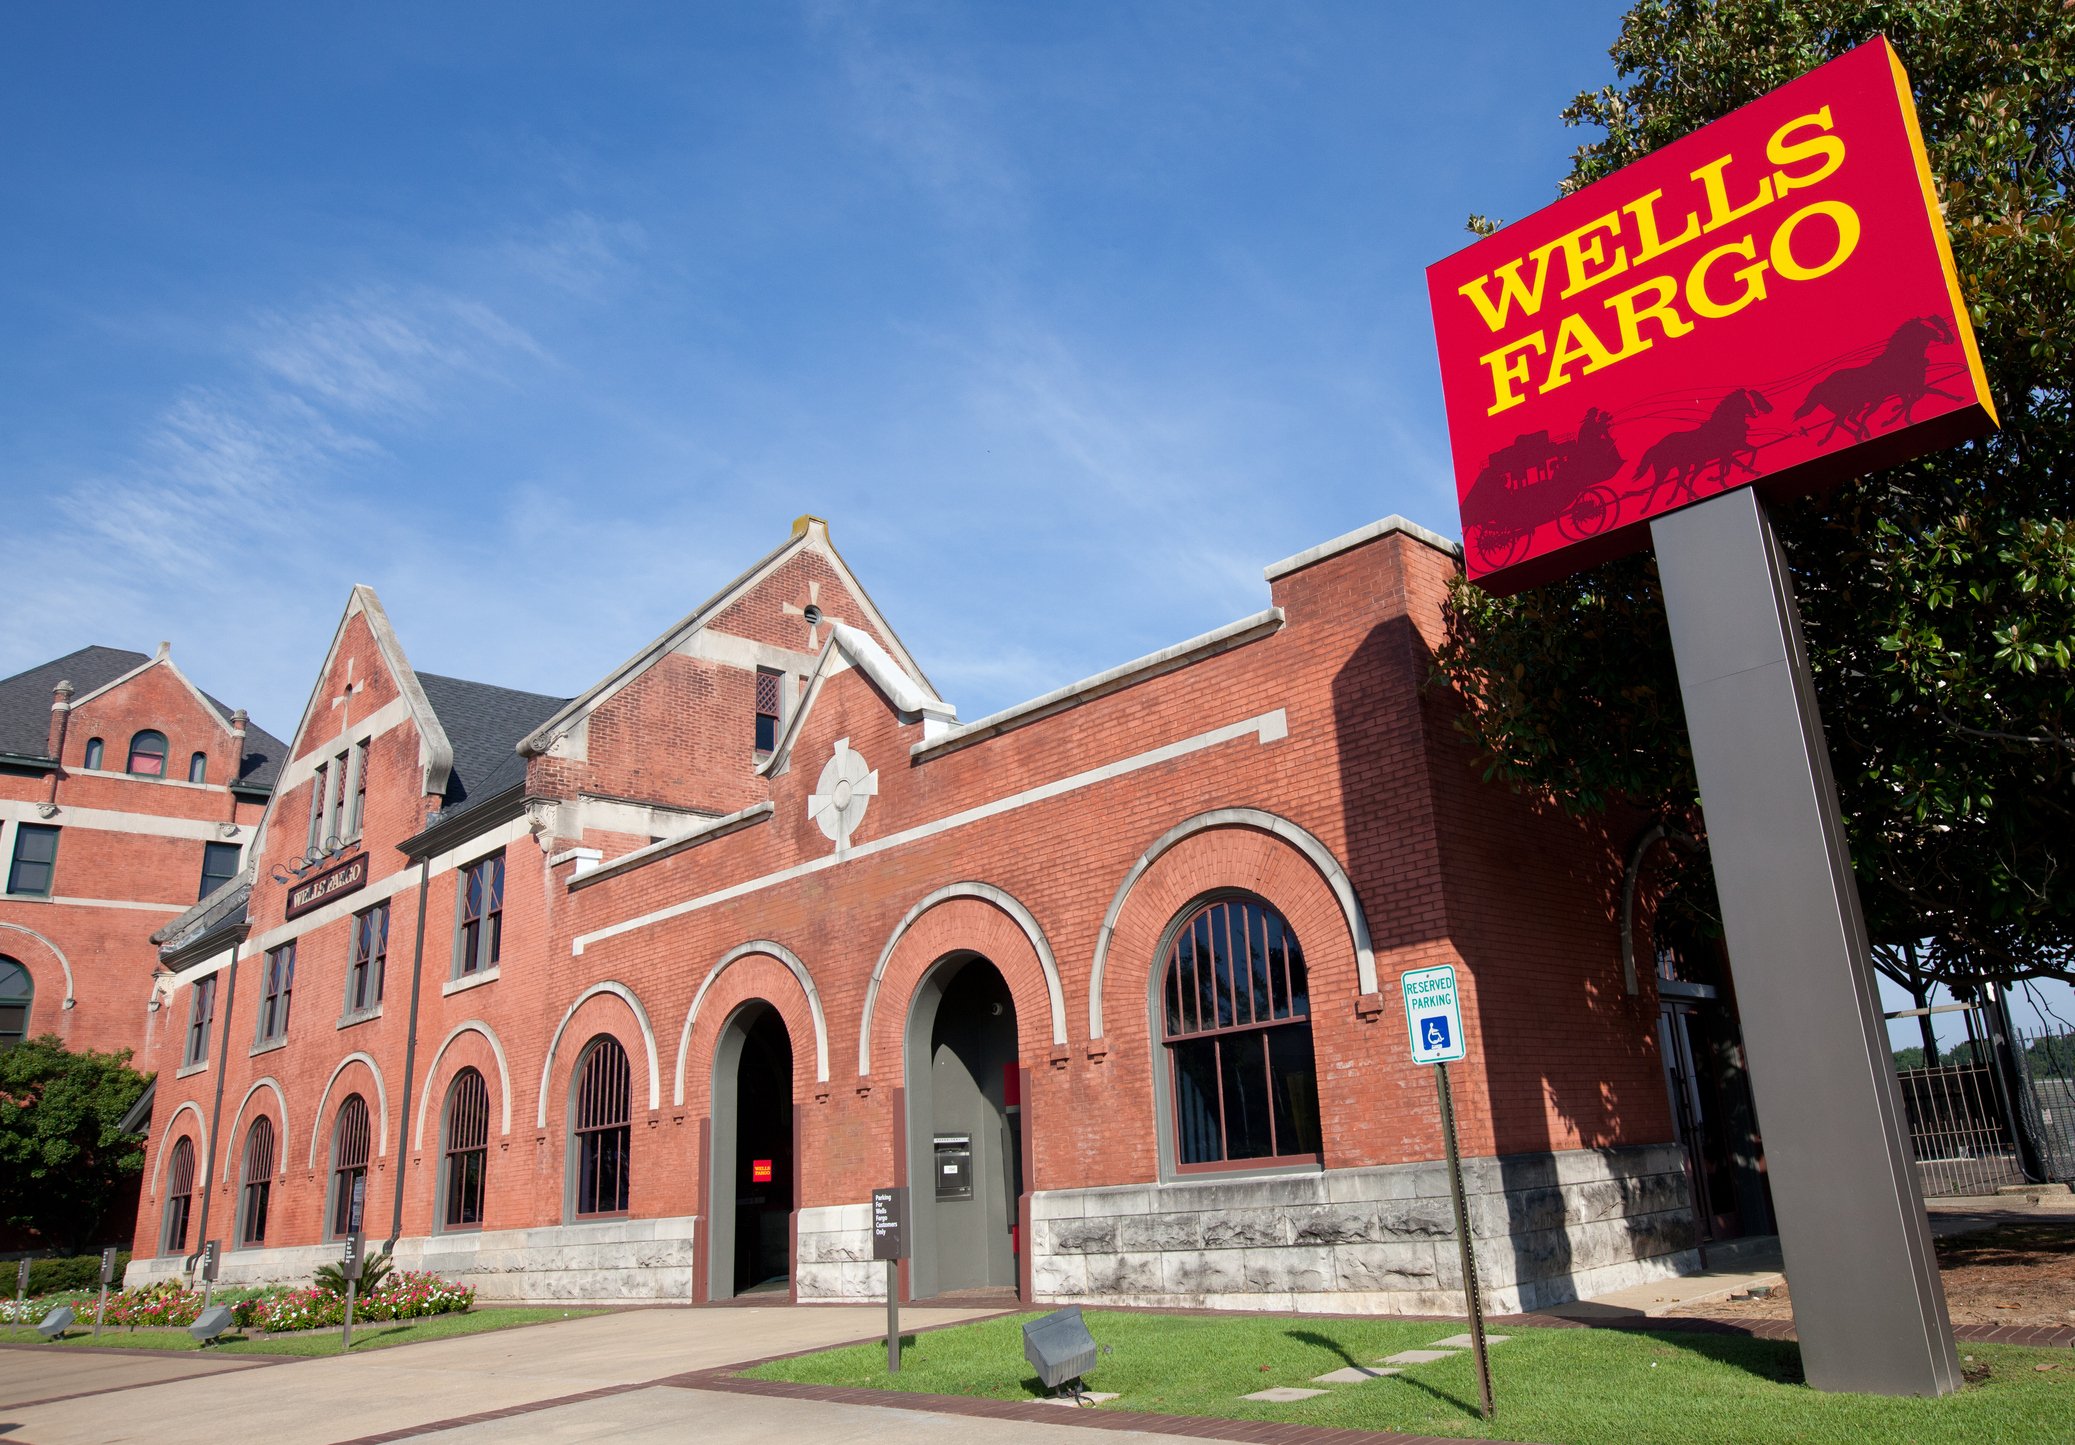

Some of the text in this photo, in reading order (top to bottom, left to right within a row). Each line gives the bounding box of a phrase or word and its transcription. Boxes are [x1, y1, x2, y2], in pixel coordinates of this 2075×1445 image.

[1458, 105, 1846, 332] WELLS
[1479, 200, 1861, 417] FARGO
[293, 864, 361, 908] WELLS FARGO
[1406, 977, 1452, 995] RESERVED
[1411, 993, 1452, 1010] PARKING
